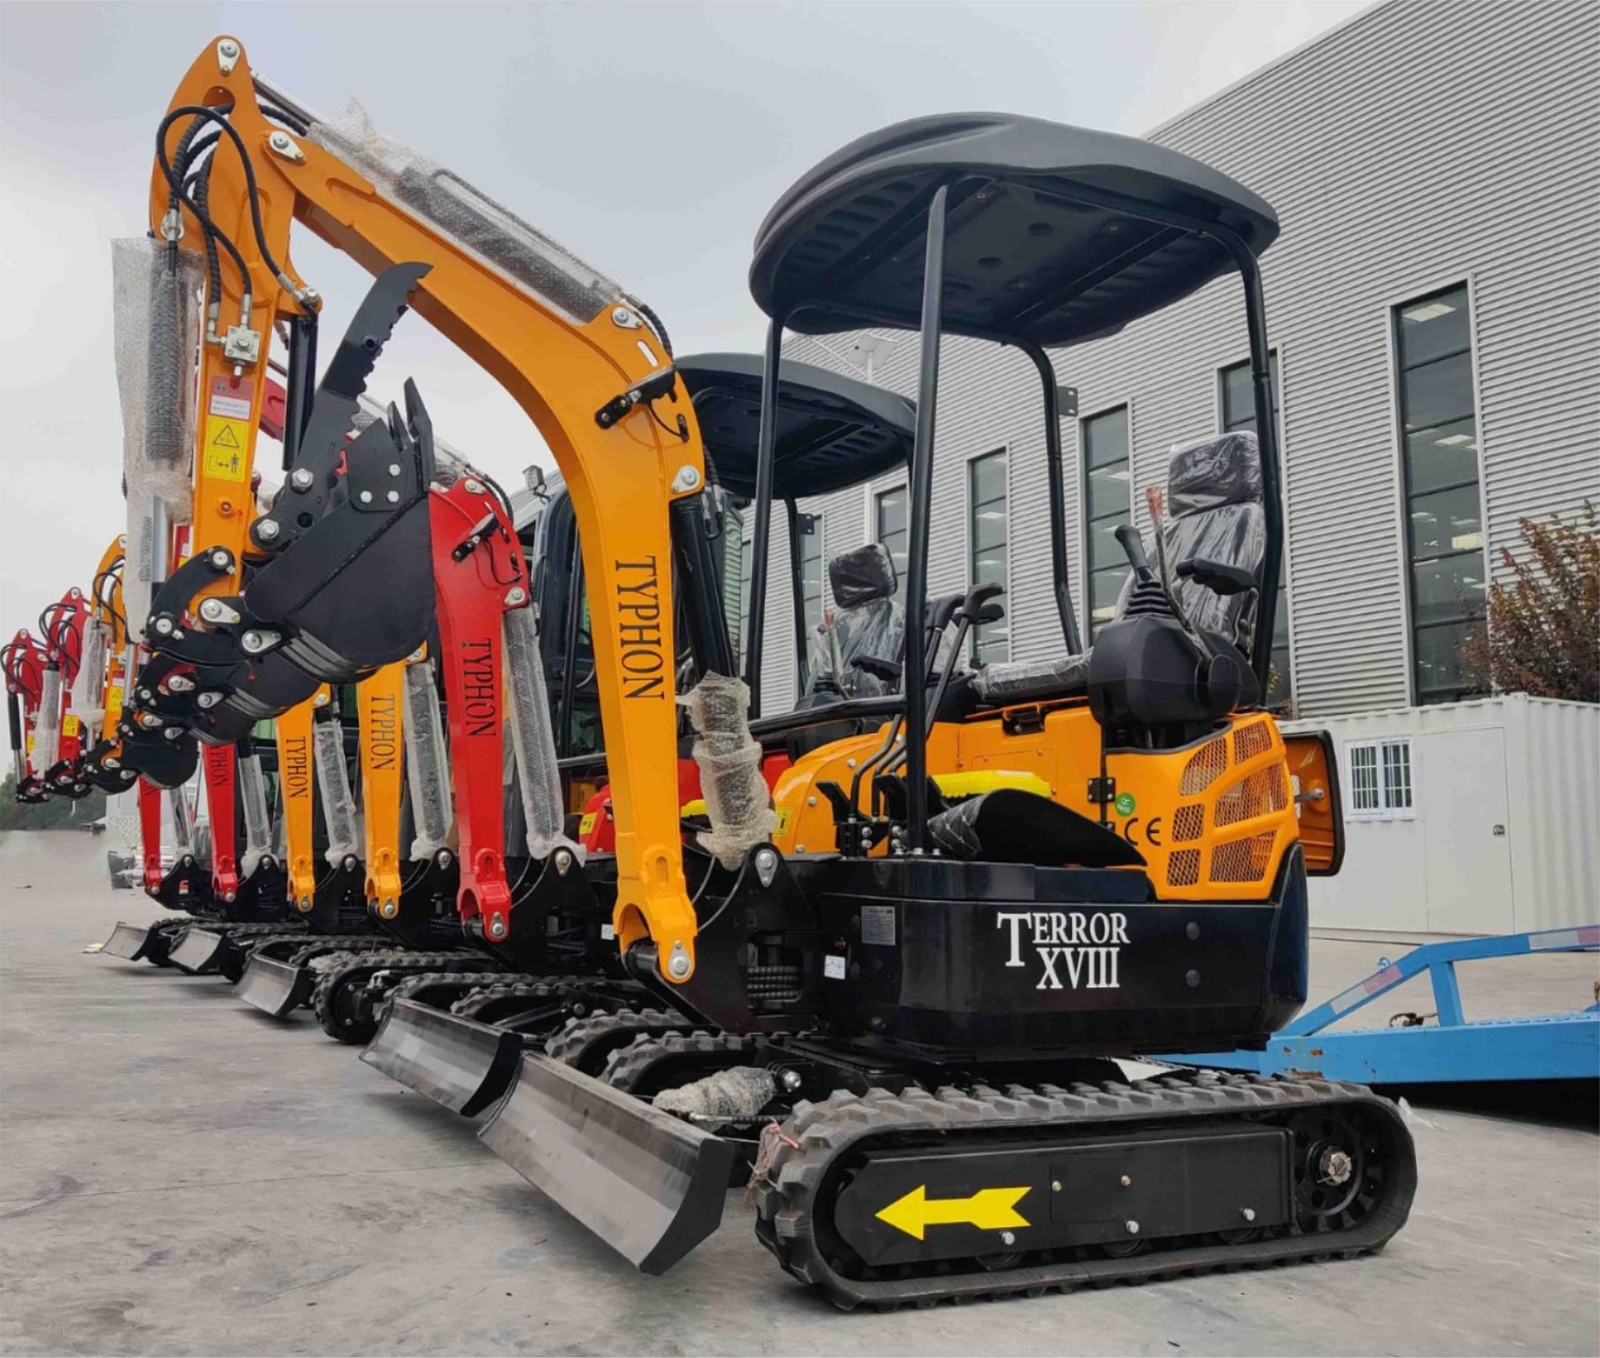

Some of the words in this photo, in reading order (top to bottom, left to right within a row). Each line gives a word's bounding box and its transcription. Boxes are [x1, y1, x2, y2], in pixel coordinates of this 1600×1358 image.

[614, 555, 665, 701] TYPHON
[462, 637, 496, 737] TYPHON
[371, 694, 395, 771] TYPHON
[210, 747, 230, 787] PHON
[286, 736, 309, 799] TYPHON
[1124, 817, 1162, 846] CE
[996, 911, 1130, 968] TERROR
[1036, 946, 1120, 991] XVIII
